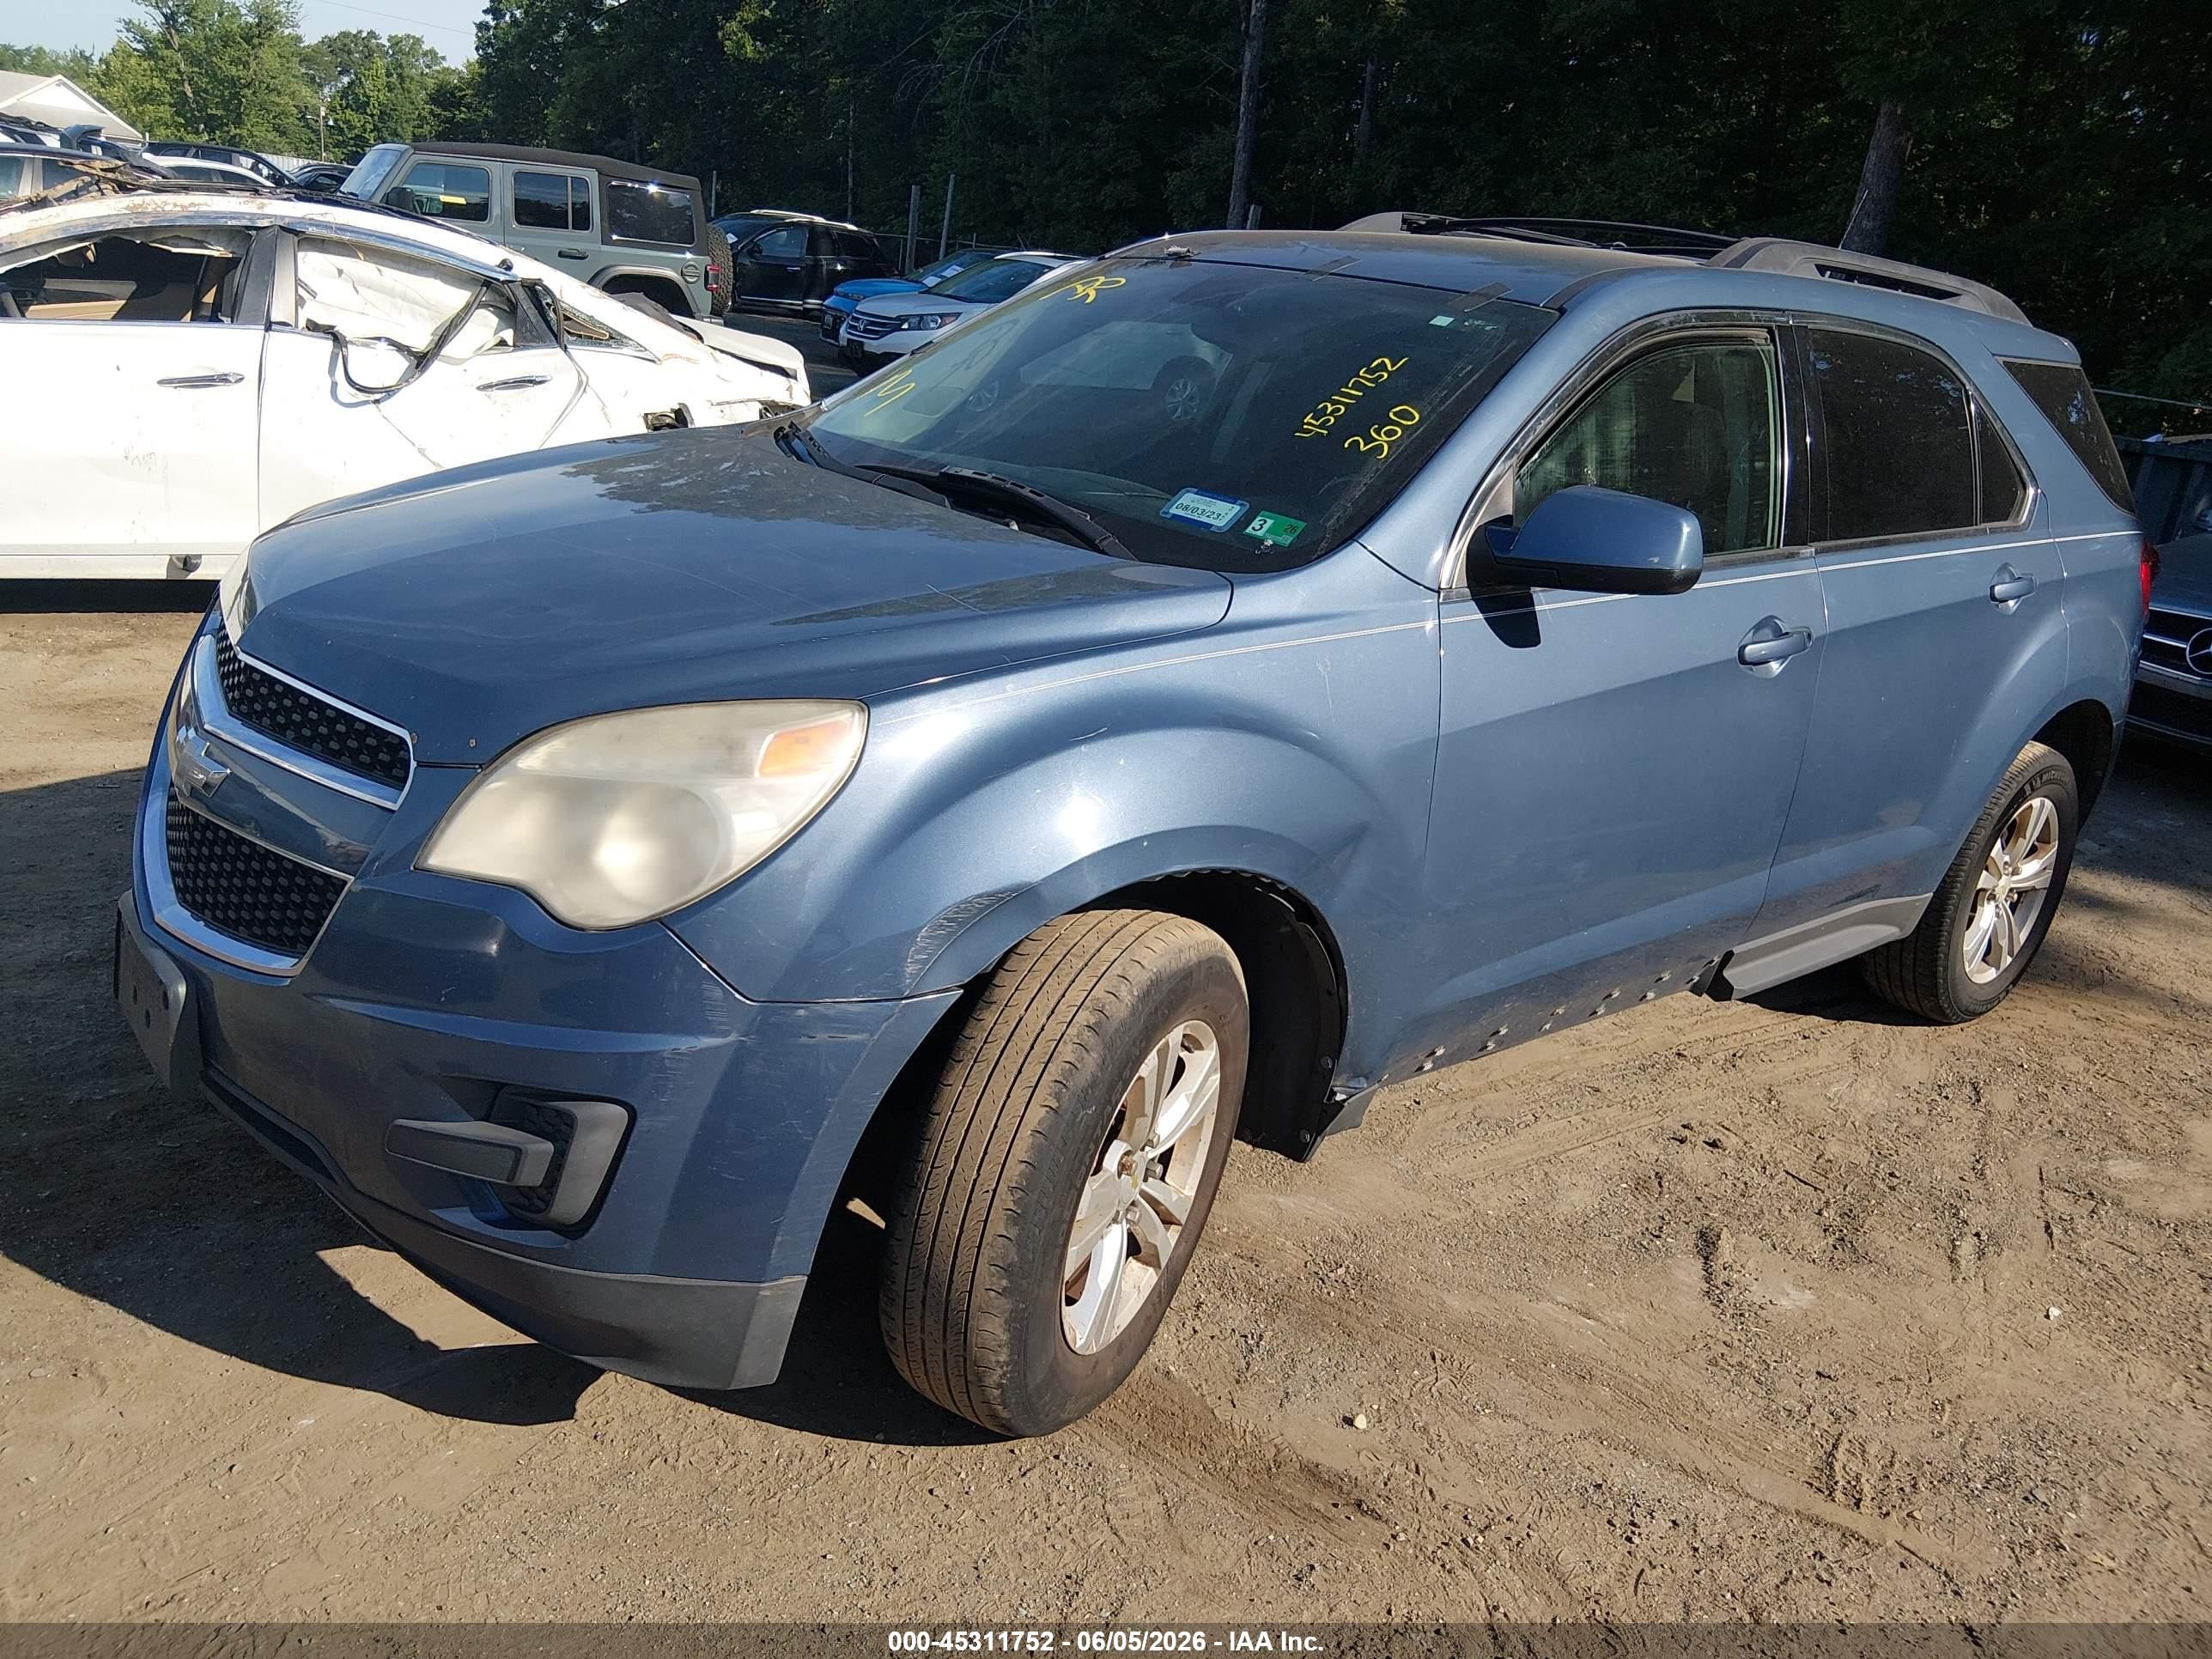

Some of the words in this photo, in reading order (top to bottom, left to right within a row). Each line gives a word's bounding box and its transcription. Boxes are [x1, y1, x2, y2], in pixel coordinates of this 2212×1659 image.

[1293, 356, 1409, 436] 45311752
[1344, 404, 1420, 459] 360
[1174, 502, 1221, 521] 08/03/23
[1251, 518, 1268, 532] 3
[1283, 523, 1299, 535] 26
